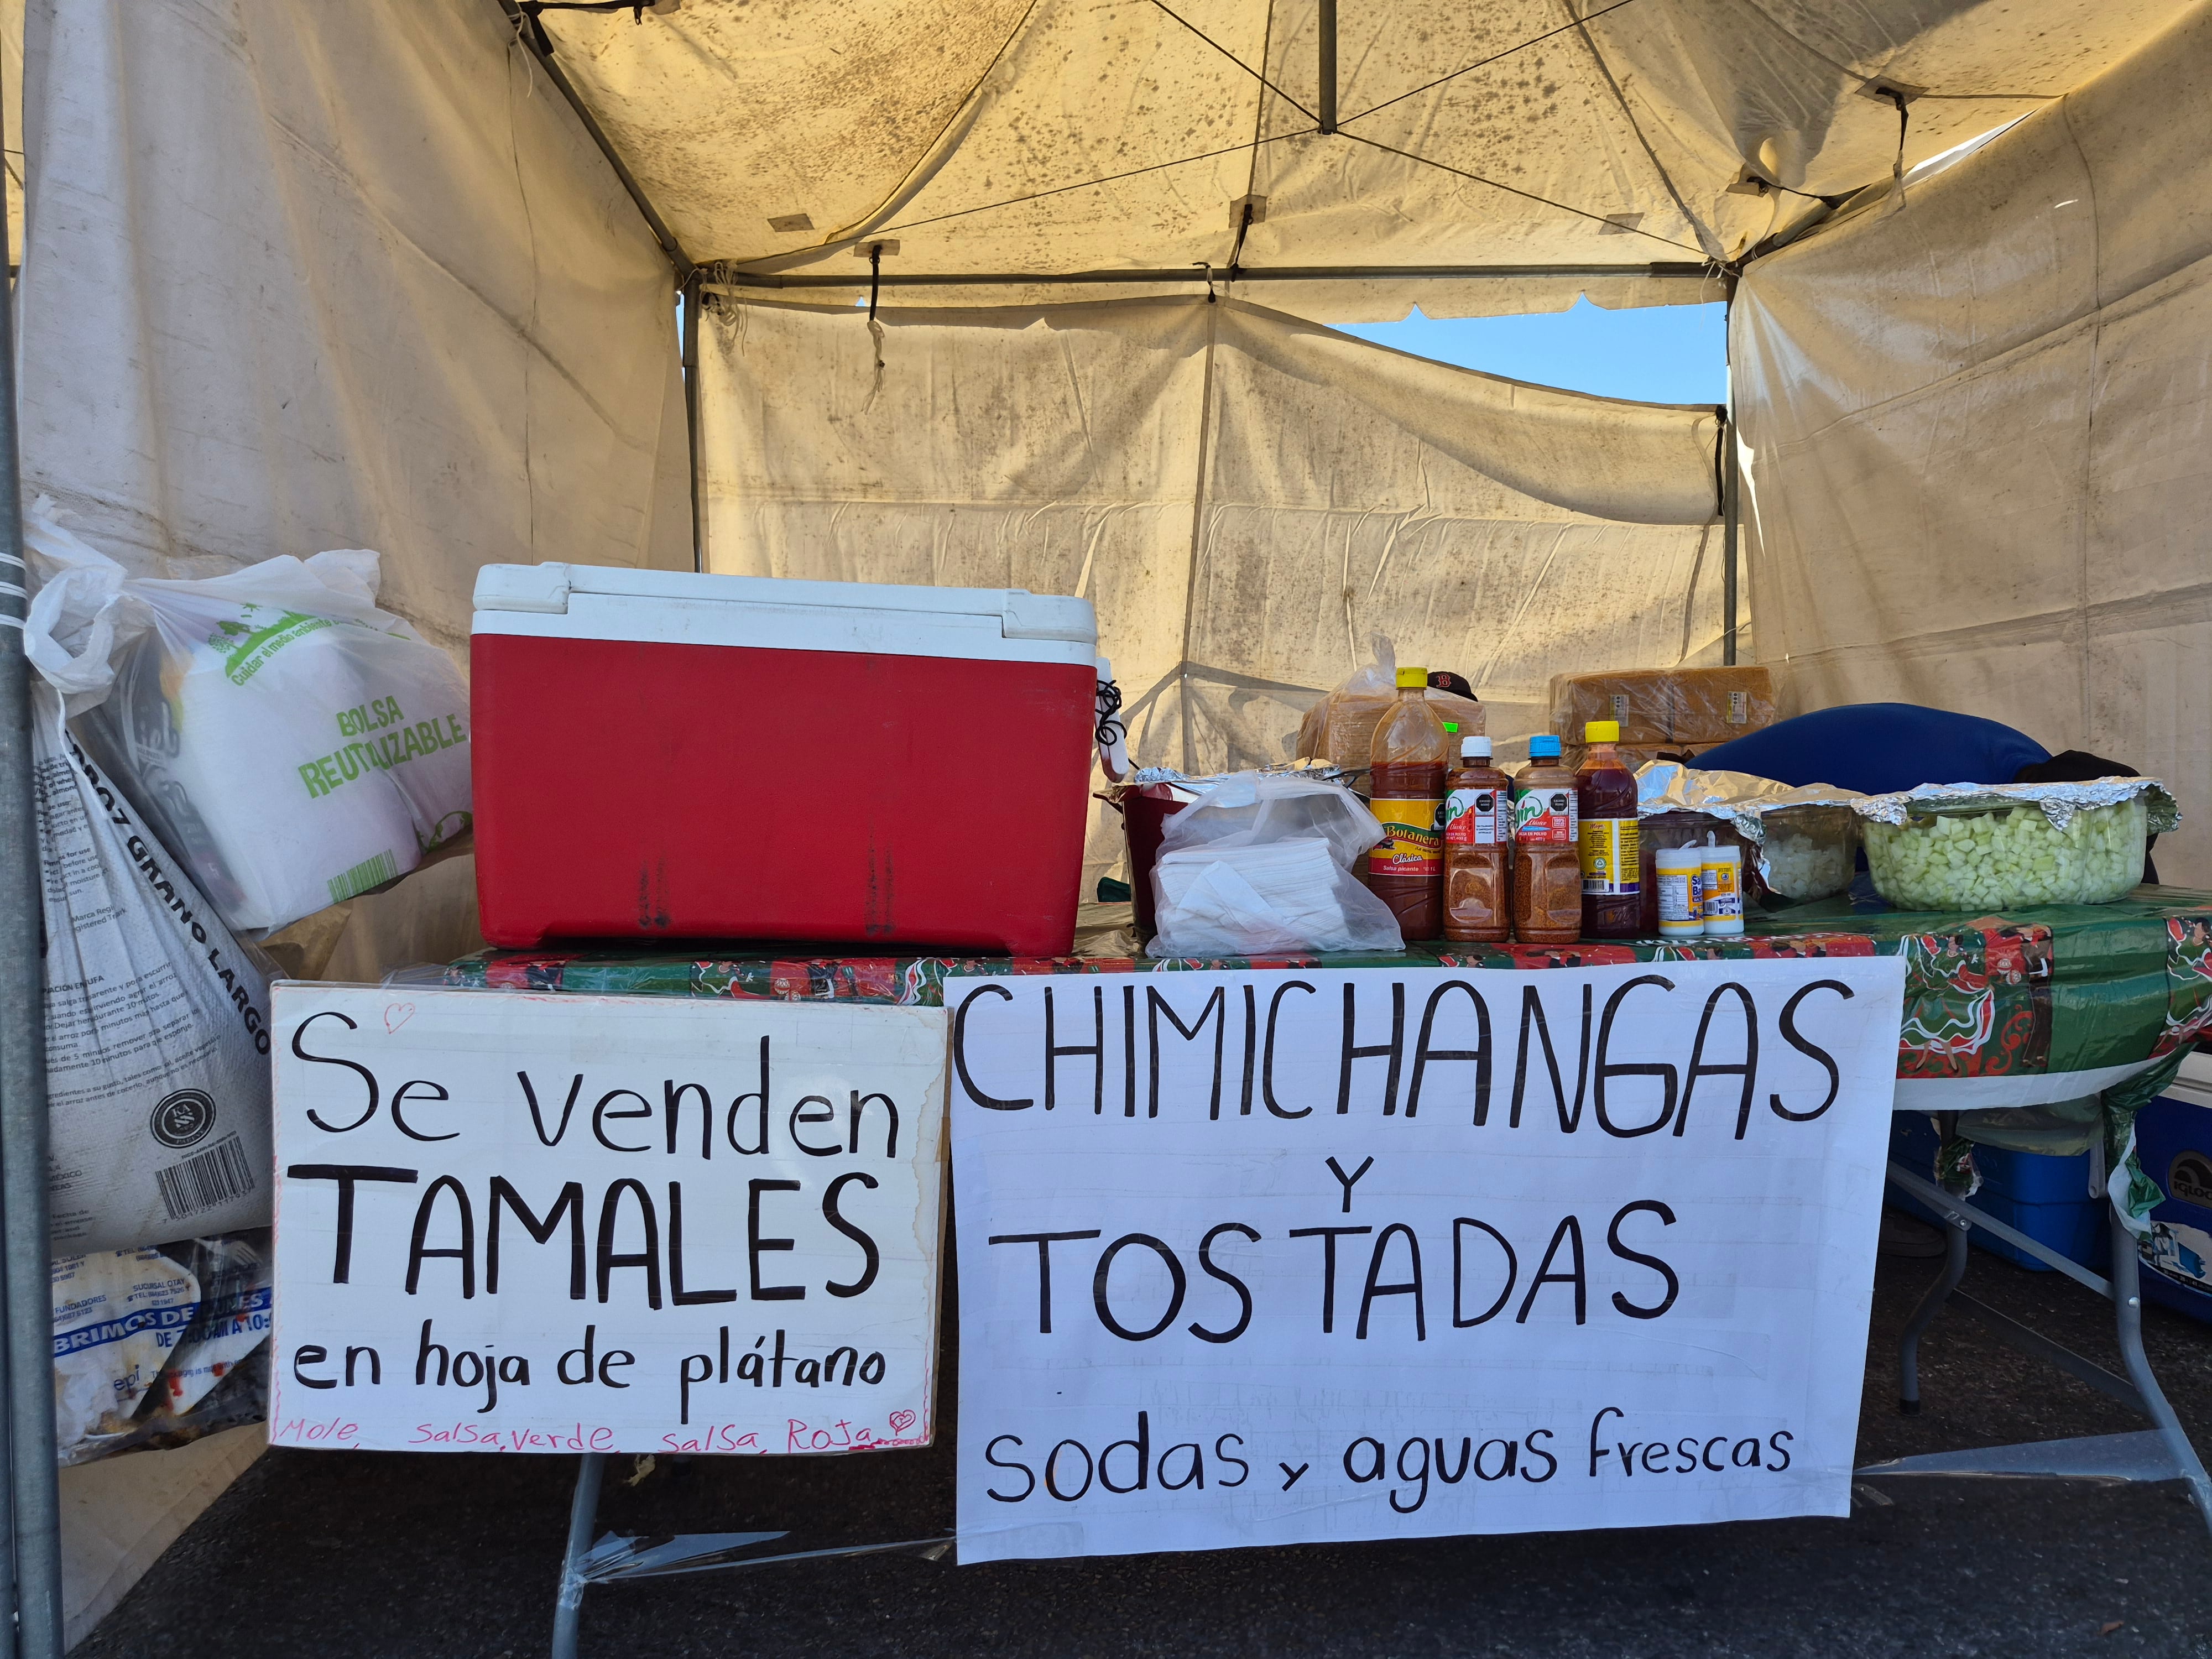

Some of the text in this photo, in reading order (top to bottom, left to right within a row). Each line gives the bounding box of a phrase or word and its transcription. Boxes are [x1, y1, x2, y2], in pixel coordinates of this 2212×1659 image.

[231, 655, 265, 686] Cuidar
[262, 646, 272, 658] el
[269, 632, 295, 654] medio
[1436, 673, 1452, 688] B
[336, 695, 405, 737] BOLSA
[298, 713, 467, 799] REUTILIZABLE
[1384, 825, 1439, 846] Botanera
[79, 847, 91, 855] use
[1392, 853, 1423, 865] Clásica
[70, 873, 101, 886] moisture
[127, 835, 207, 943] GRANO
[208, 948, 271, 1055] LARGO
[58, 998, 77, 1007] salga
[56, 1021, 75, 1030] Dejar
[101, 1016, 133, 1031] minutos
[150, 1000, 171, 1013] hasta
[163, 1013, 190, 1030] separar
[91, 1058, 101, 1066] 10
[134, 1041, 151, 1052] para
[953, 975, 1854, 1140] CHIMICHANGAS
[292, 1012, 898, 1160] Se venden
[1326, 1156, 1374, 1212] Y
[288, 1165, 879, 1310] TAMALES
[989, 1197, 1678, 1343] TOSTADAS
[133, 1277, 186, 1292] SUCURSAL OTAY
[55, 1294, 107, 1314] FUNDADORES
[161, 1306, 195, 1327] DE
[155, 1331, 173, 1348] DE
[294, 1319, 885, 1425] en hoja de plátano
[986, 1411, 1248, 1502] sodas
[1344, 1430, 1557, 1513] aguas
[1590, 1407, 1793, 1477] frescas
